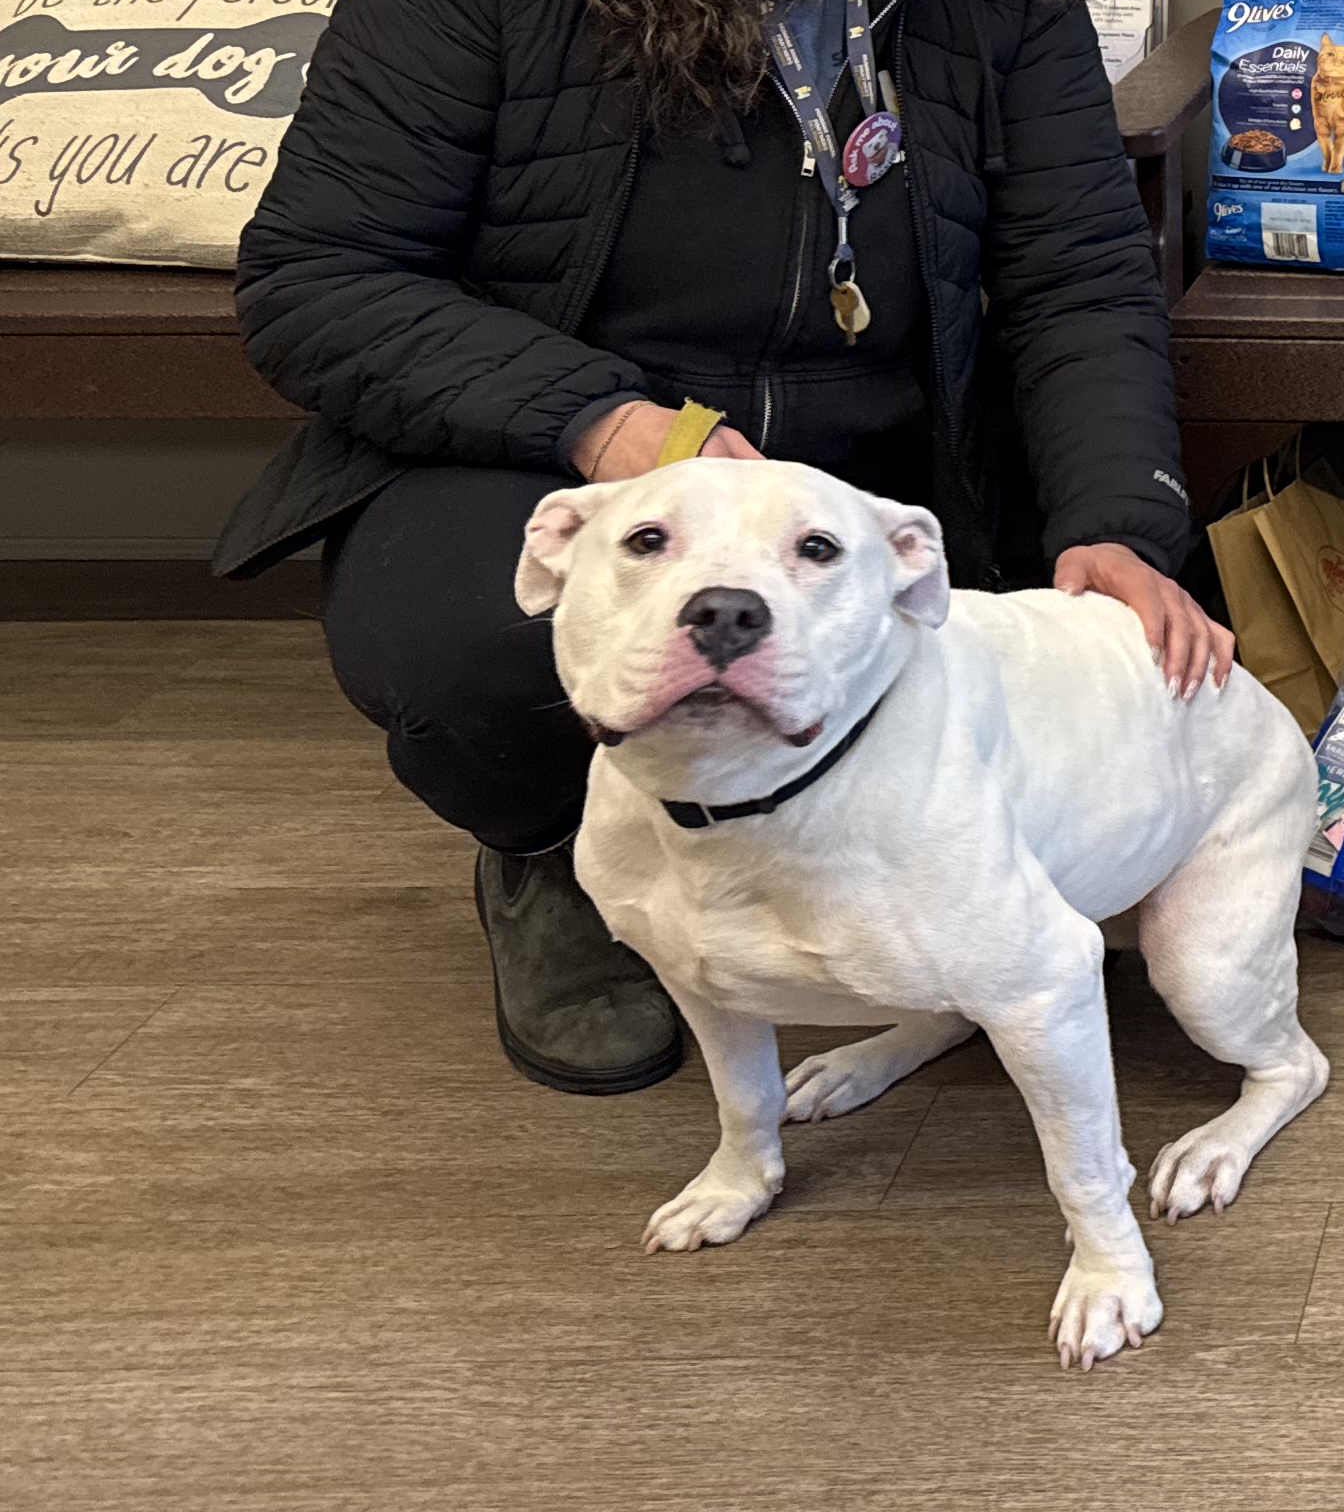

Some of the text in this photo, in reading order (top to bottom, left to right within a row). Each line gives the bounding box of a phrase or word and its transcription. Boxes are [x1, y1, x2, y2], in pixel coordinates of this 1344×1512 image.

[0, 41, 140, 87] our
[152, 32, 297, 105] dog
[1238, 58, 1308, 74] Essentials
[1272, 46, 1310, 62] Daily
[34, 133, 158, 217] you
[166, 134, 269, 193] are
